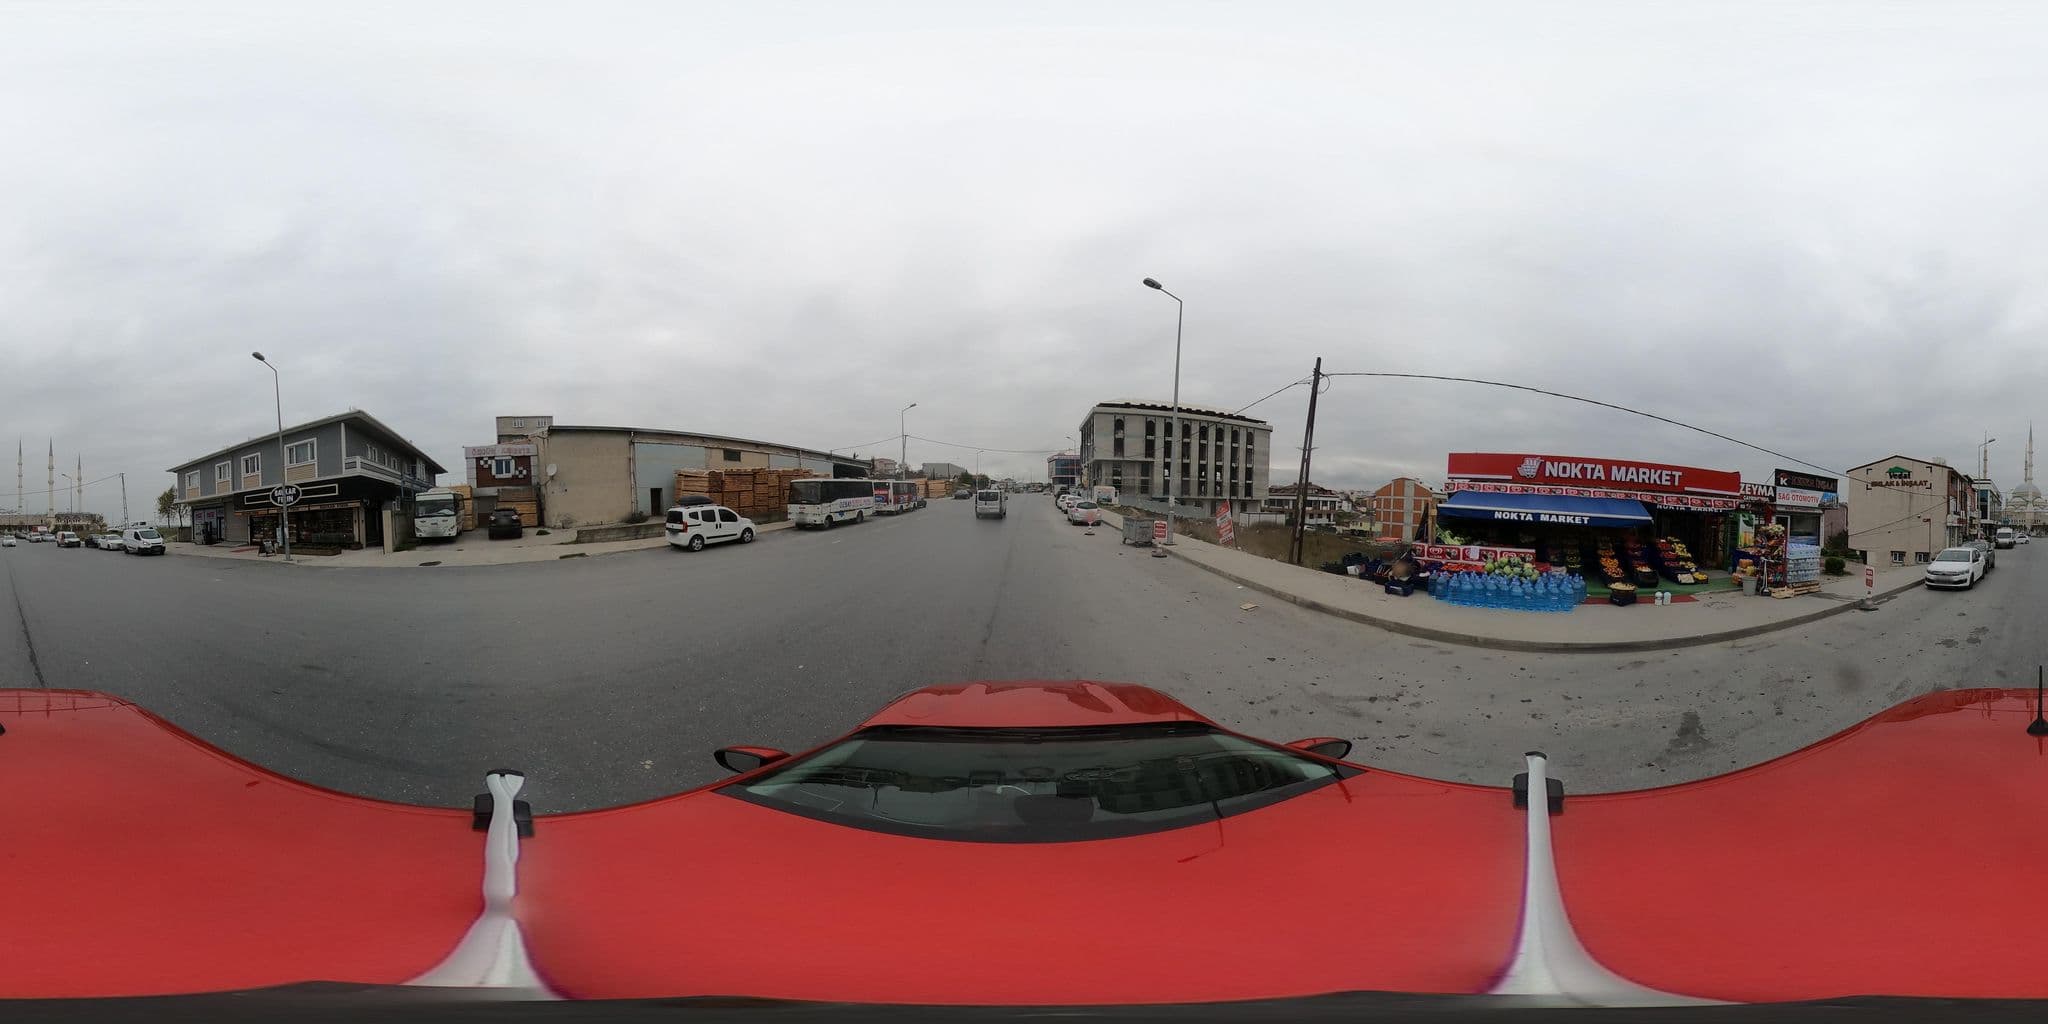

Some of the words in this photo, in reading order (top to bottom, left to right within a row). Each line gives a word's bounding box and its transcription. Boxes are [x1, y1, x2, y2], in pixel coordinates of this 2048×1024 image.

[1545, 461, 1605, 481] NOKTA
[1611, 465, 1682, 486] MARKET
[1901, 479, 1928, 488] İNŞAAT
[1739, 484, 1774, 497] ZEYMA
[1494, 511, 1533, 521] NOKTA
[1540, 513, 1590, 525] MARKET
